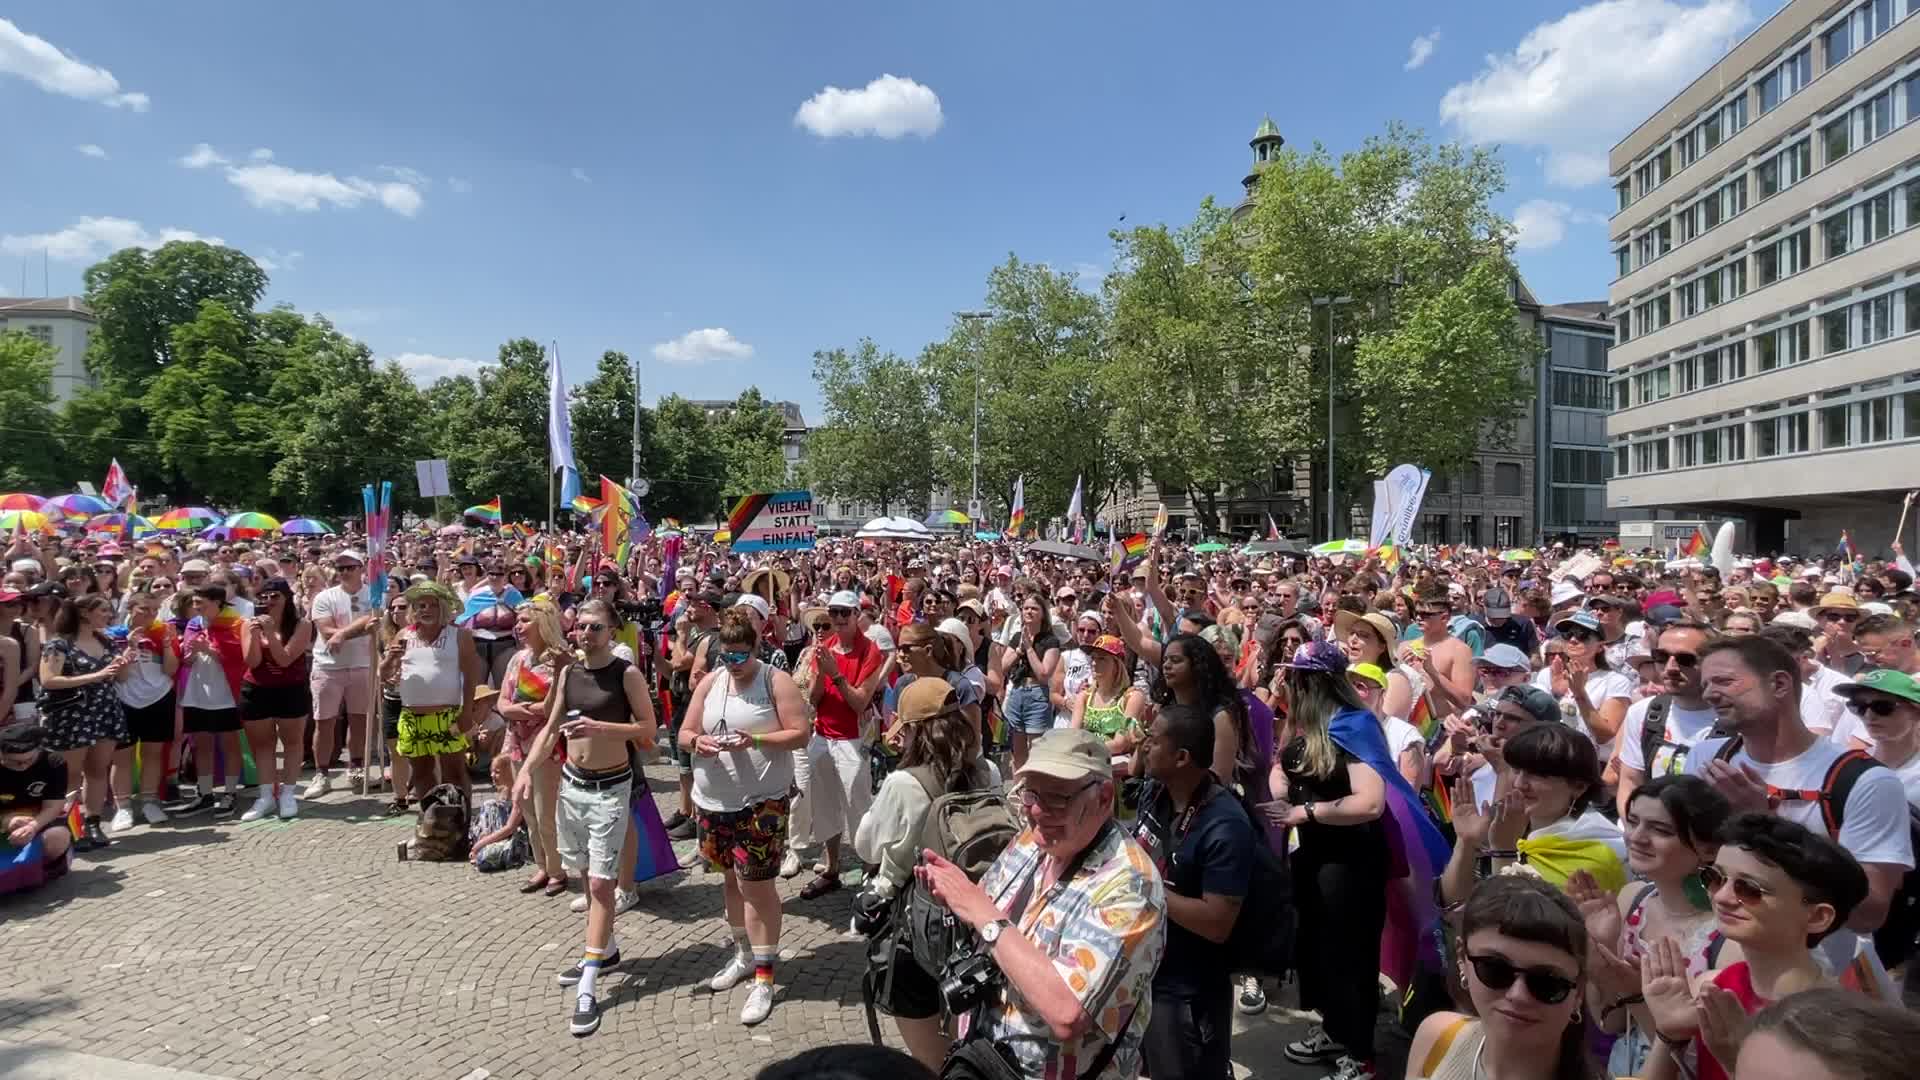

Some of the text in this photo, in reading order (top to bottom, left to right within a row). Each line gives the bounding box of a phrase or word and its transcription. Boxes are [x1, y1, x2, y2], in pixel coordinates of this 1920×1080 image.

[768, 500, 811, 514] VIELFALT
[774, 515, 809, 528] STATT
[762, 531, 814, 545] EINFALT
